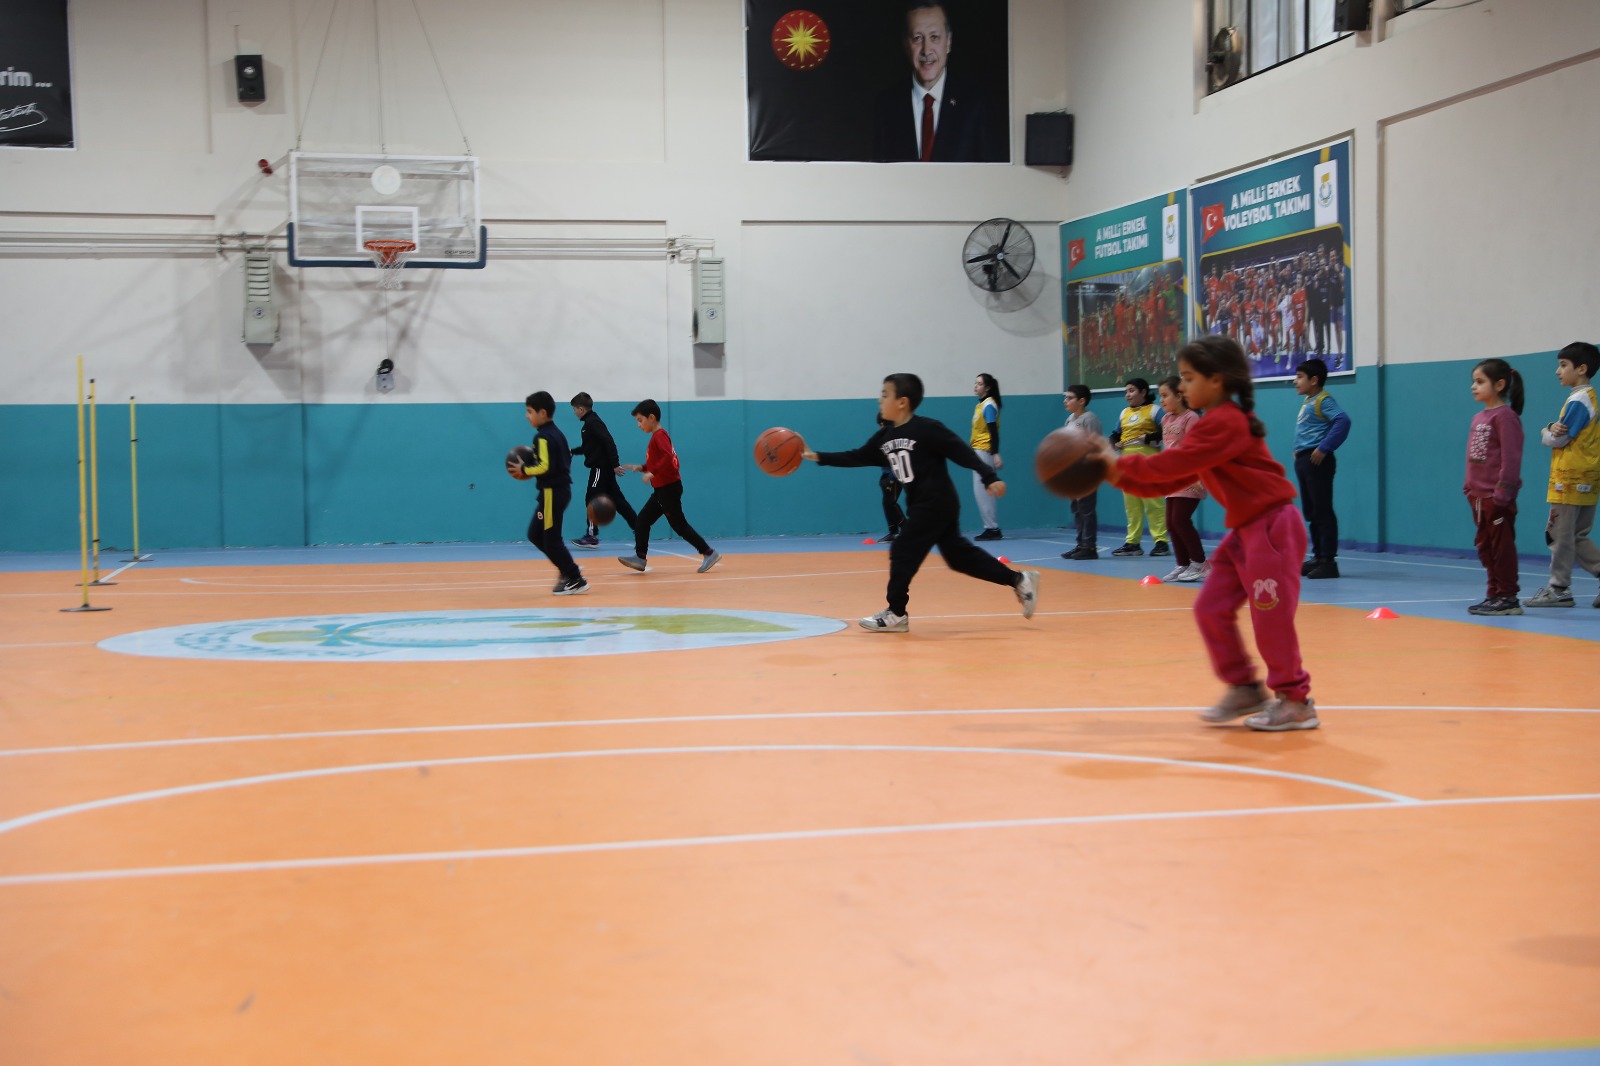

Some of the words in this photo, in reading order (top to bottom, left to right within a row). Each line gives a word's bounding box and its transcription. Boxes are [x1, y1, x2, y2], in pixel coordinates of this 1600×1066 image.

[1231, 193, 1240, 211] A
[1267, 175, 1302, 201] ERKEK
[1223, 204, 1273, 232] VOLEYBOL
[1274, 193, 1312, 218] TAKIMI
[1096, 228, 1103, 243] A
[1122, 216, 1148, 236] ERKEK
[1094, 240, 1122, 260] FUTBOL
[1122, 233, 1149, 253] TAKIMI
[879, 440, 894, 455] NEW
[894, 437, 918, 451] YORK
